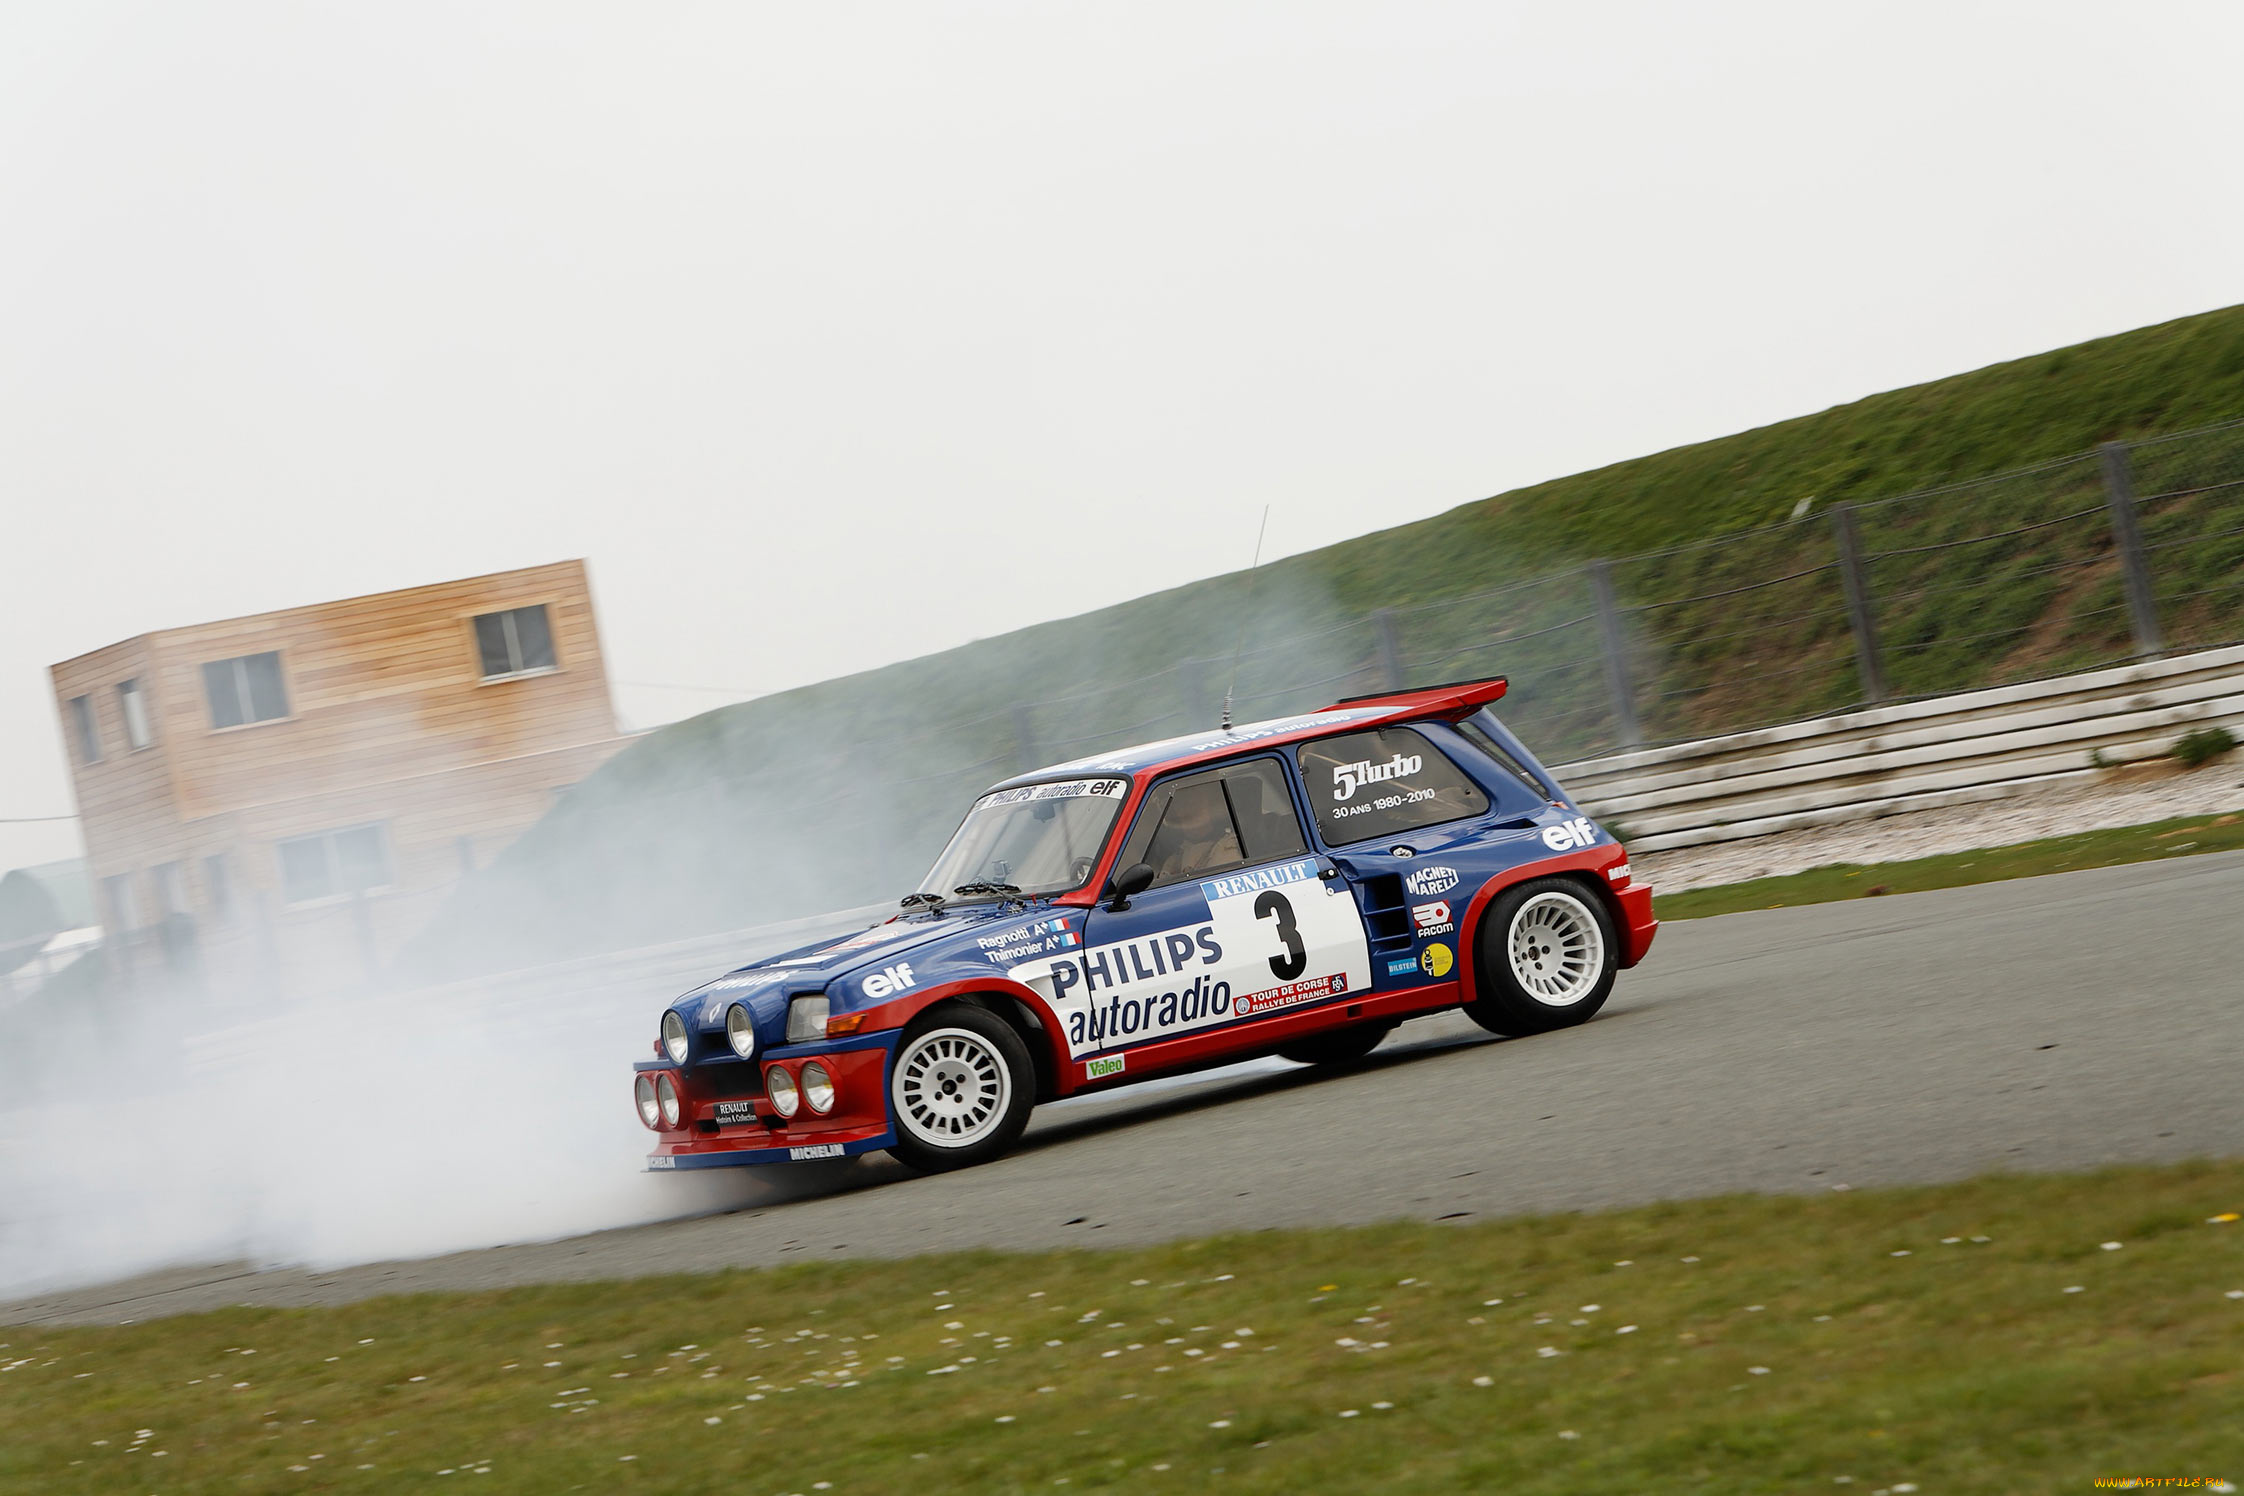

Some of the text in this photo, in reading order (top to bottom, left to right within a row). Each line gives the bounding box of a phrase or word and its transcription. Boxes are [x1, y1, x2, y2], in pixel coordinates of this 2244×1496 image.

[1036, 781, 1087, 799] autoradio
[1089, 780, 1120, 796] elf
[1373, 788, 1436, 810] 1980-2010
[1542, 817, 1596, 851] elf
[1213, 862, 1308, 899] RENAULT
[977, 927, 1030, 949] Ragnotti
[1254, 890, 1307, 981] 3
[1417, 922, 1454, 938] FACOM
[984, 942, 1043, 963] Thimonier
[1050, 926, 1223, 999] PHILIPS
[862, 962, 917, 998] elf
[1251, 977, 1329, 1003] TOUR DE CORSE
[1069, 974, 1231, 1046] autoradio
[1252, 987, 1330, 1012] RALLYE DE FRANCE
[1089, 1059, 1122, 1077] Valeo
[719, 1102, 749, 1115] RENAULT
[789, 1143, 846, 1161] MICHELIN
